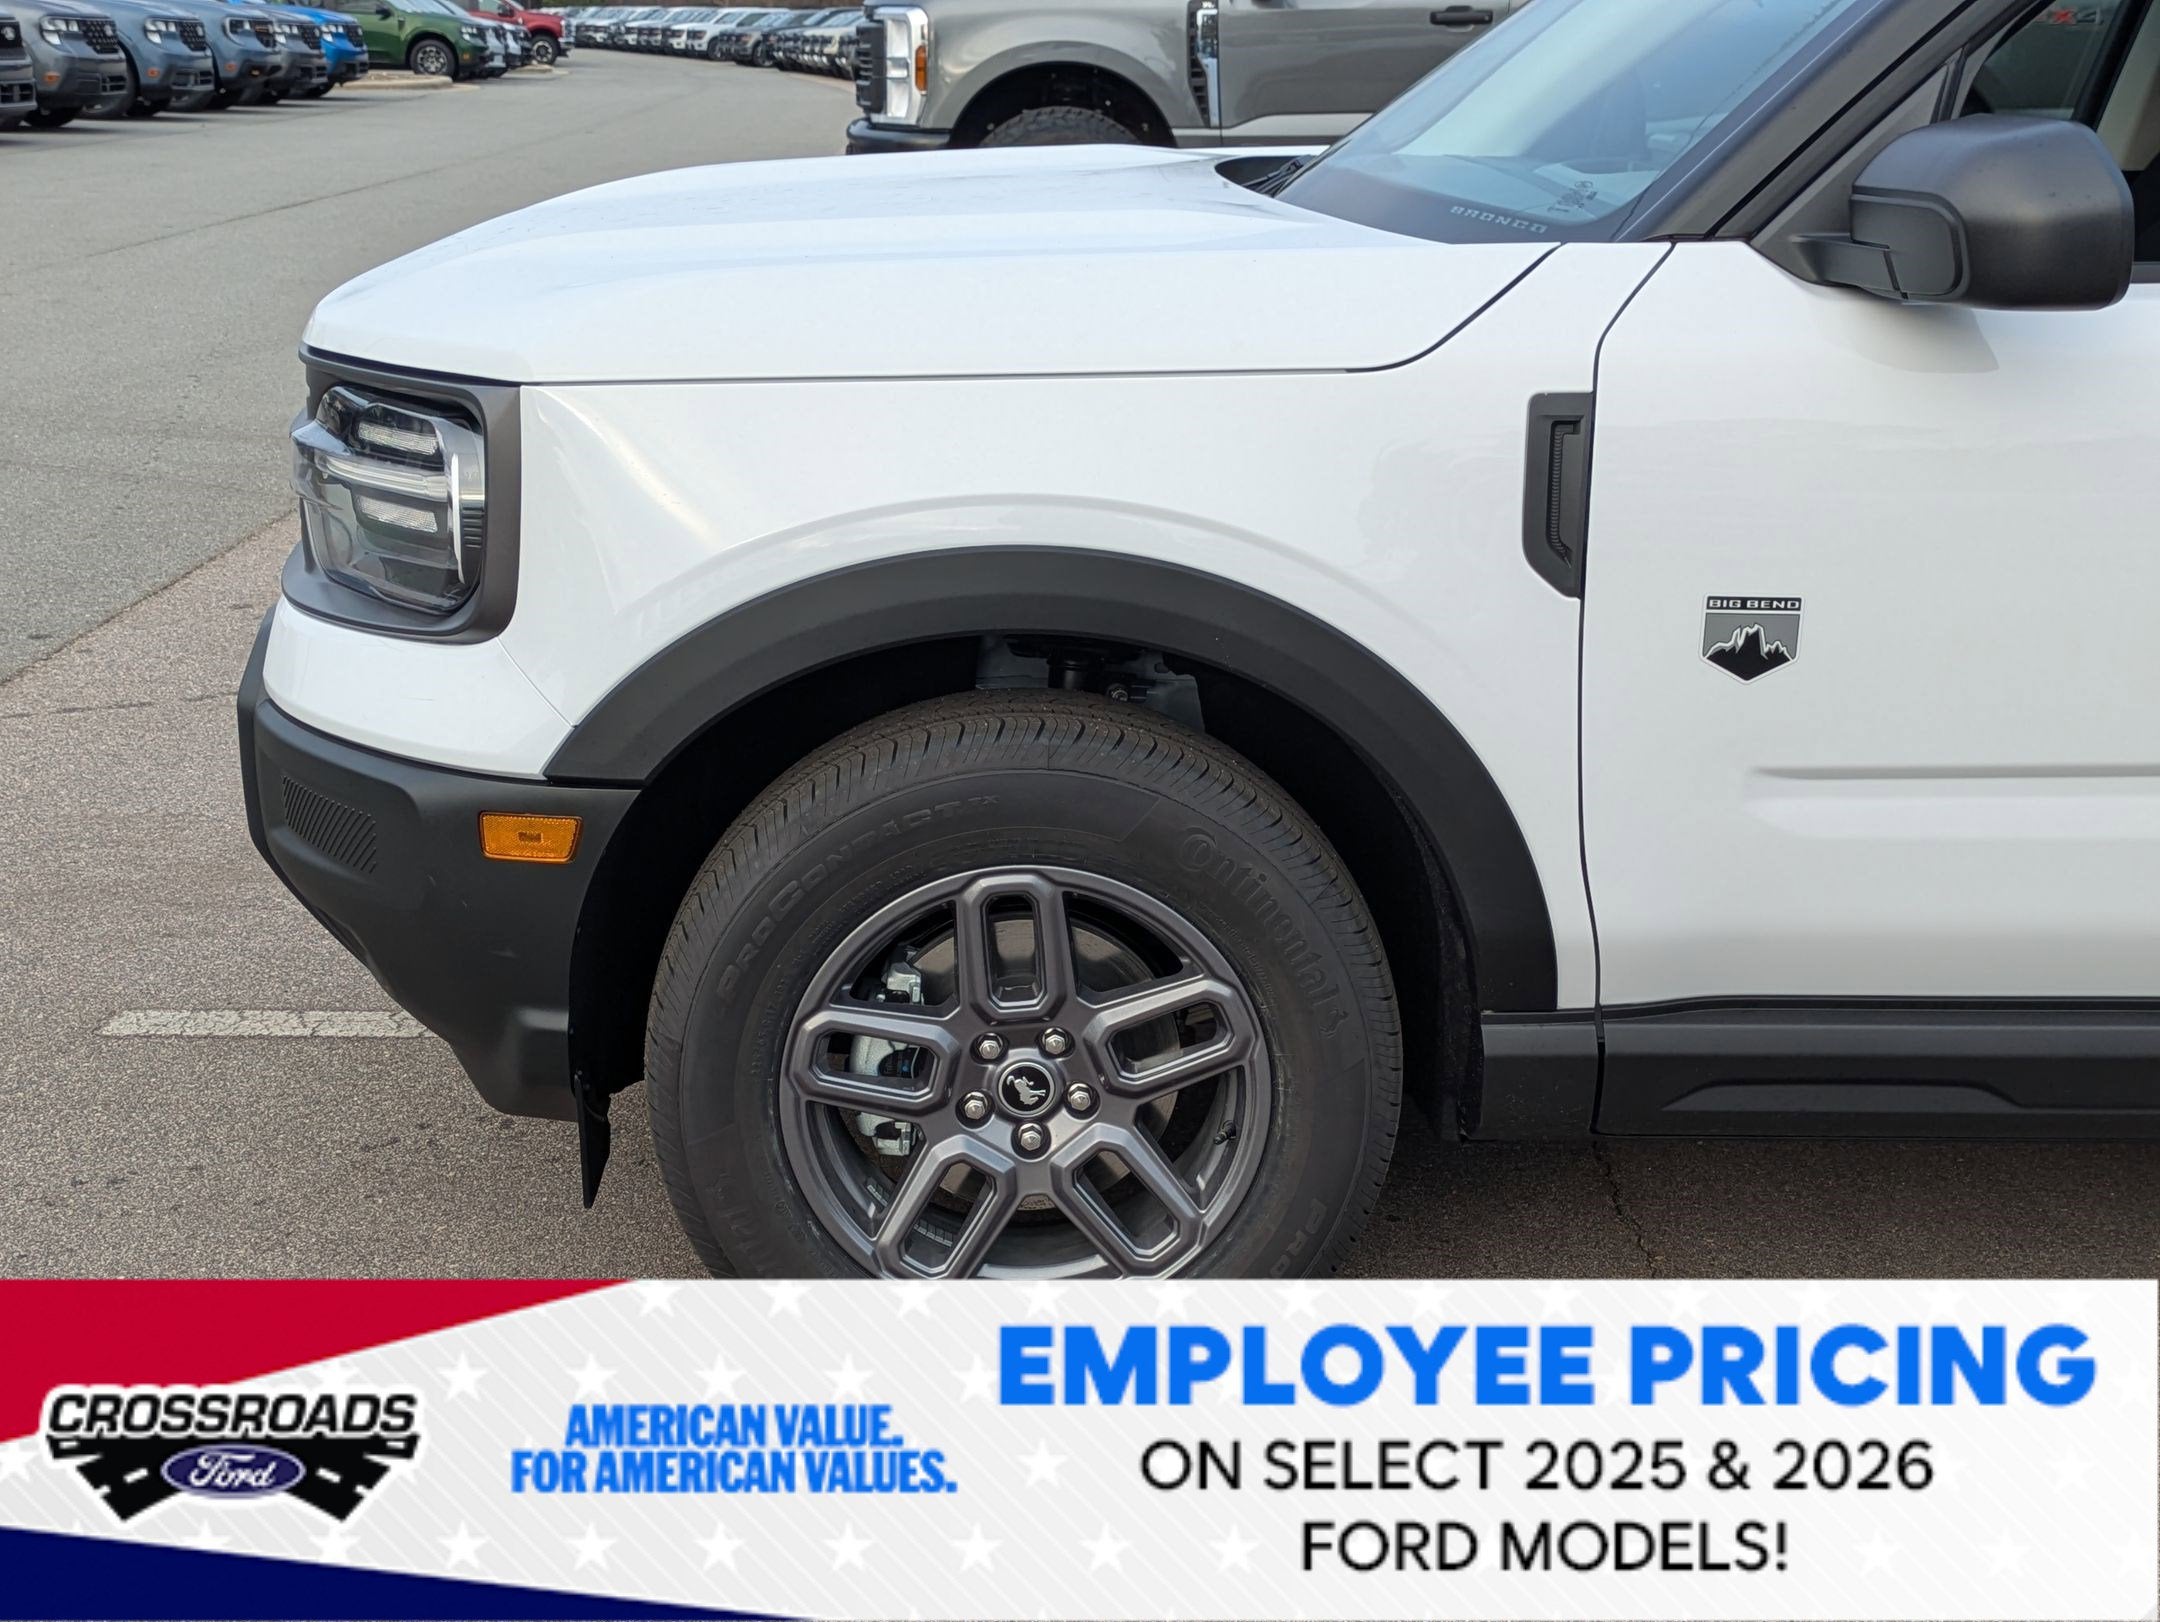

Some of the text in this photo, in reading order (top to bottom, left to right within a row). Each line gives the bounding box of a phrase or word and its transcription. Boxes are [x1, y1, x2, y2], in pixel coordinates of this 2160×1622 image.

[1450, 205, 1548, 234] BRONCO
[1708, 599, 1800, 609] BIG BEND
[1177, 825, 1340, 1008] Continental
